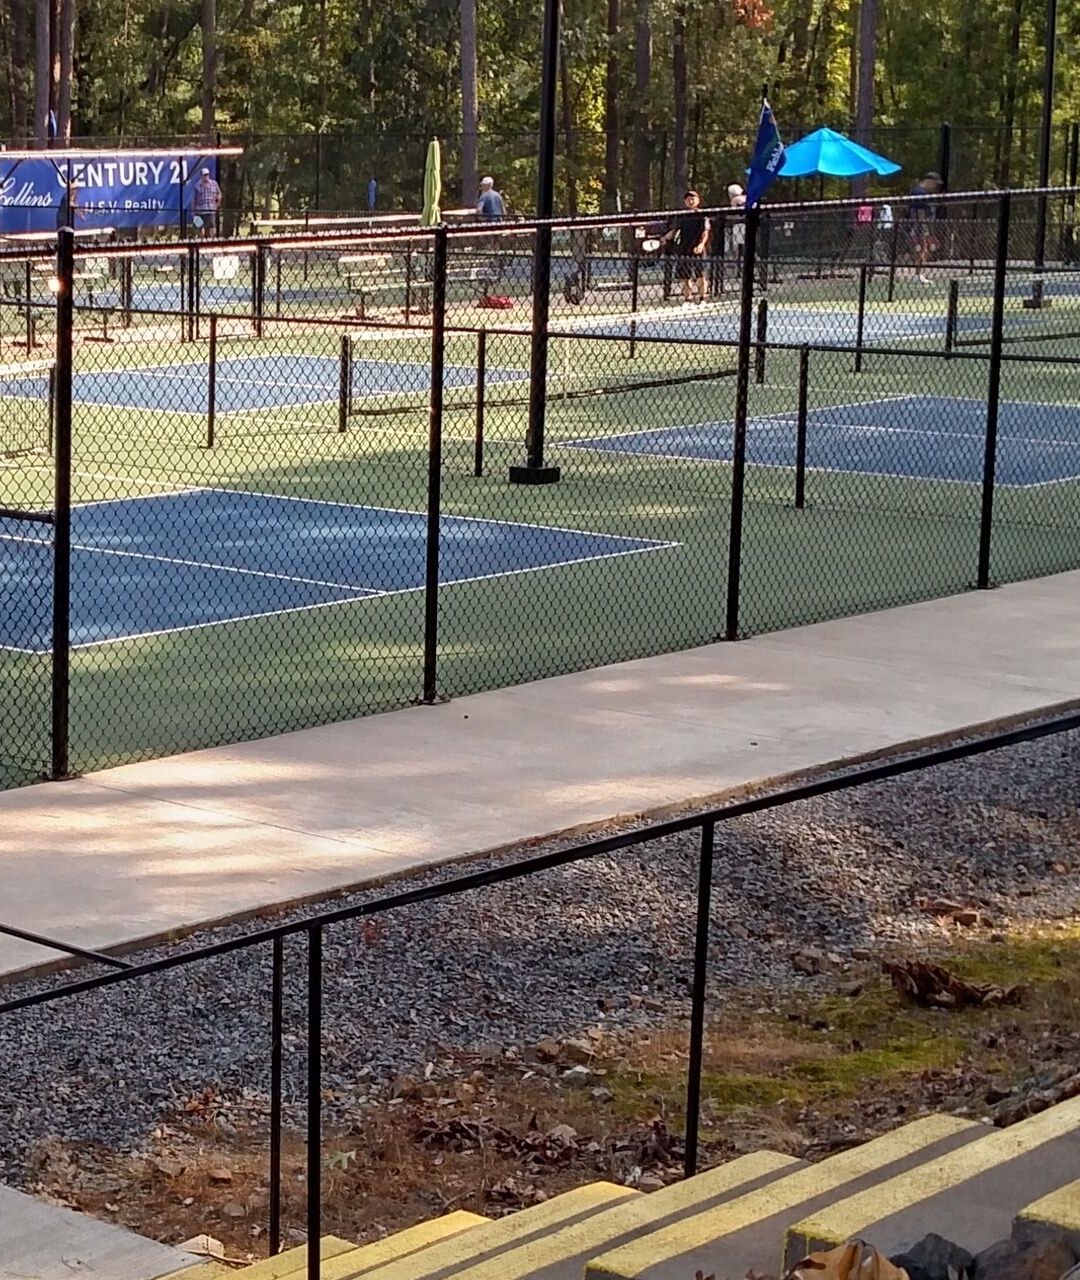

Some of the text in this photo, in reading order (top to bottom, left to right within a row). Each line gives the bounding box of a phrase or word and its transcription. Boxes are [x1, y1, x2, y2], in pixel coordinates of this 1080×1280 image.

[56, 160, 189, 189] CENTURY 21
[124, 198, 165, 214] Realty
